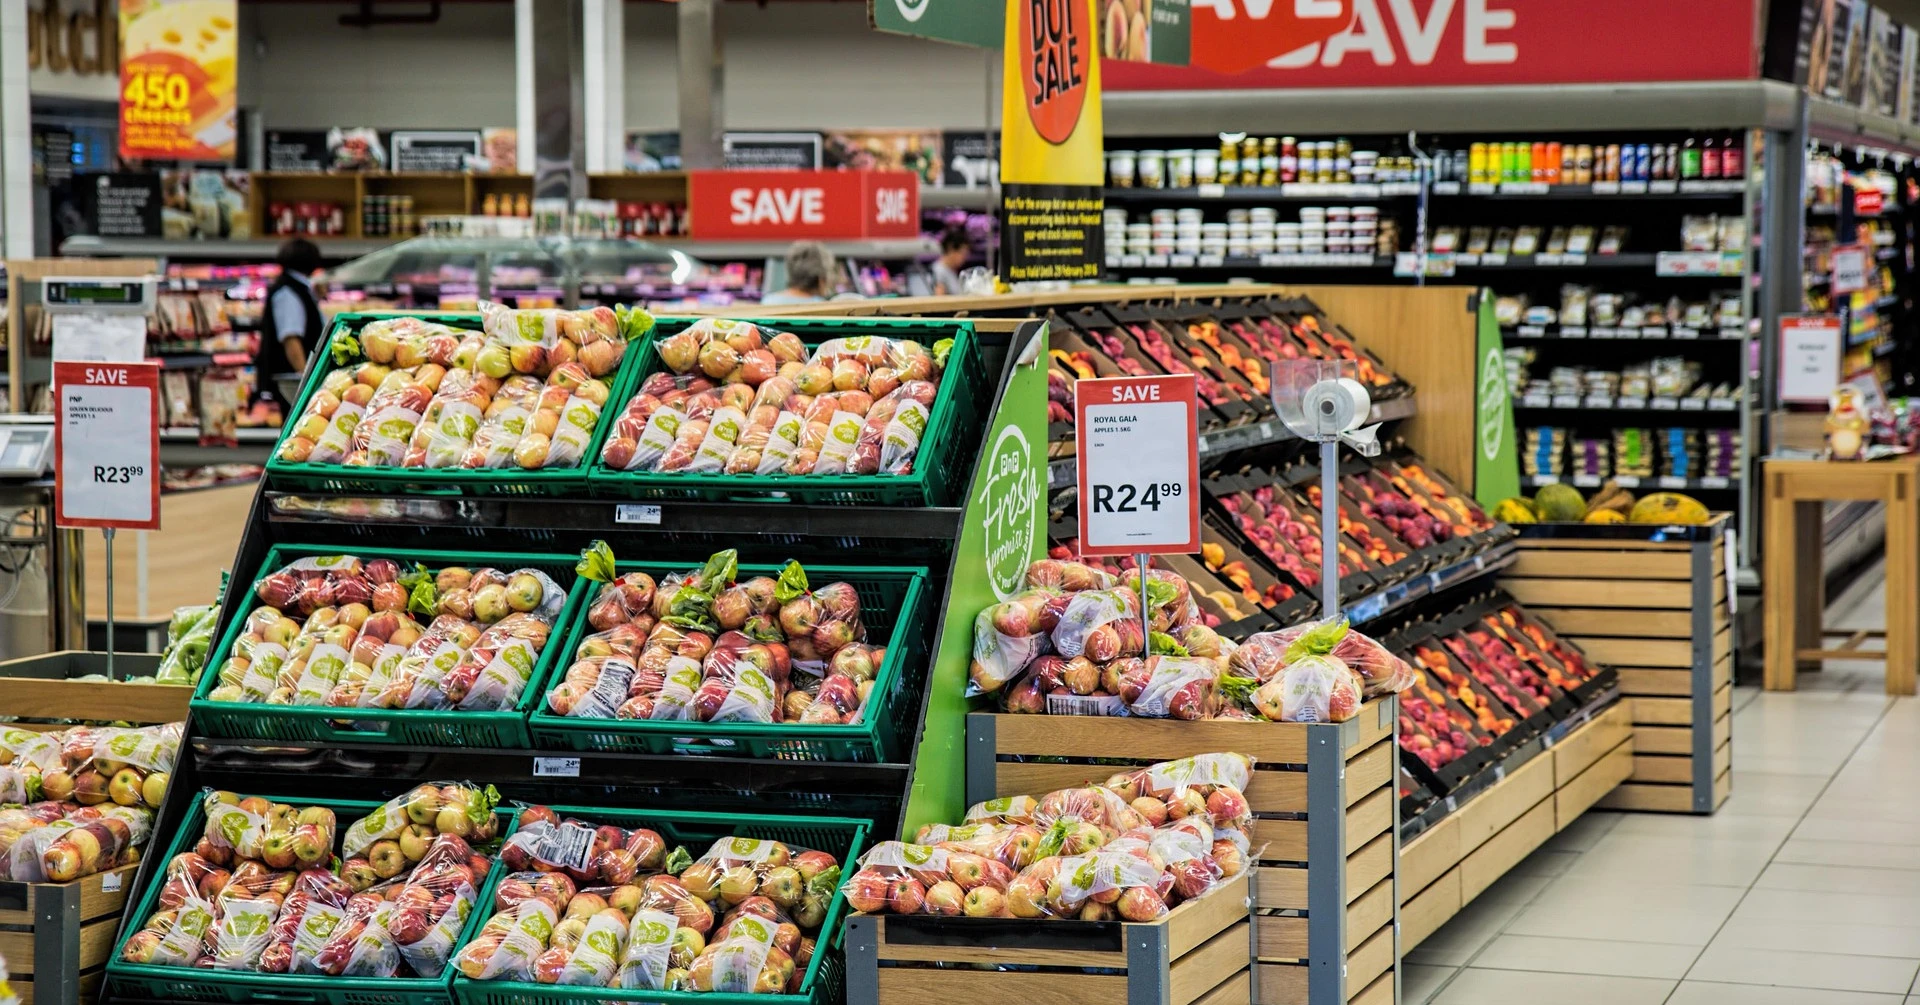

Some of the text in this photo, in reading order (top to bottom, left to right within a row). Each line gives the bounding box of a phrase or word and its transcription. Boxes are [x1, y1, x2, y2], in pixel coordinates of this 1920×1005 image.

[1266, 0, 1518, 68] AVE
[1032, 36, 1081, 107] SALE
[124, 73, 190, 109] 450
[730, 188, 825, 225] SAVE
[876, 188, 909, 224] SAVE
[85, 368, 128, 385] SAVE
[1112, 384, 1160, 402] SAVE
[1094, 415, 1137, 424] ROYAL GALA
[1000, 451, 1020, 477] PnP
[979, 443, 1041, 540] Fresh
